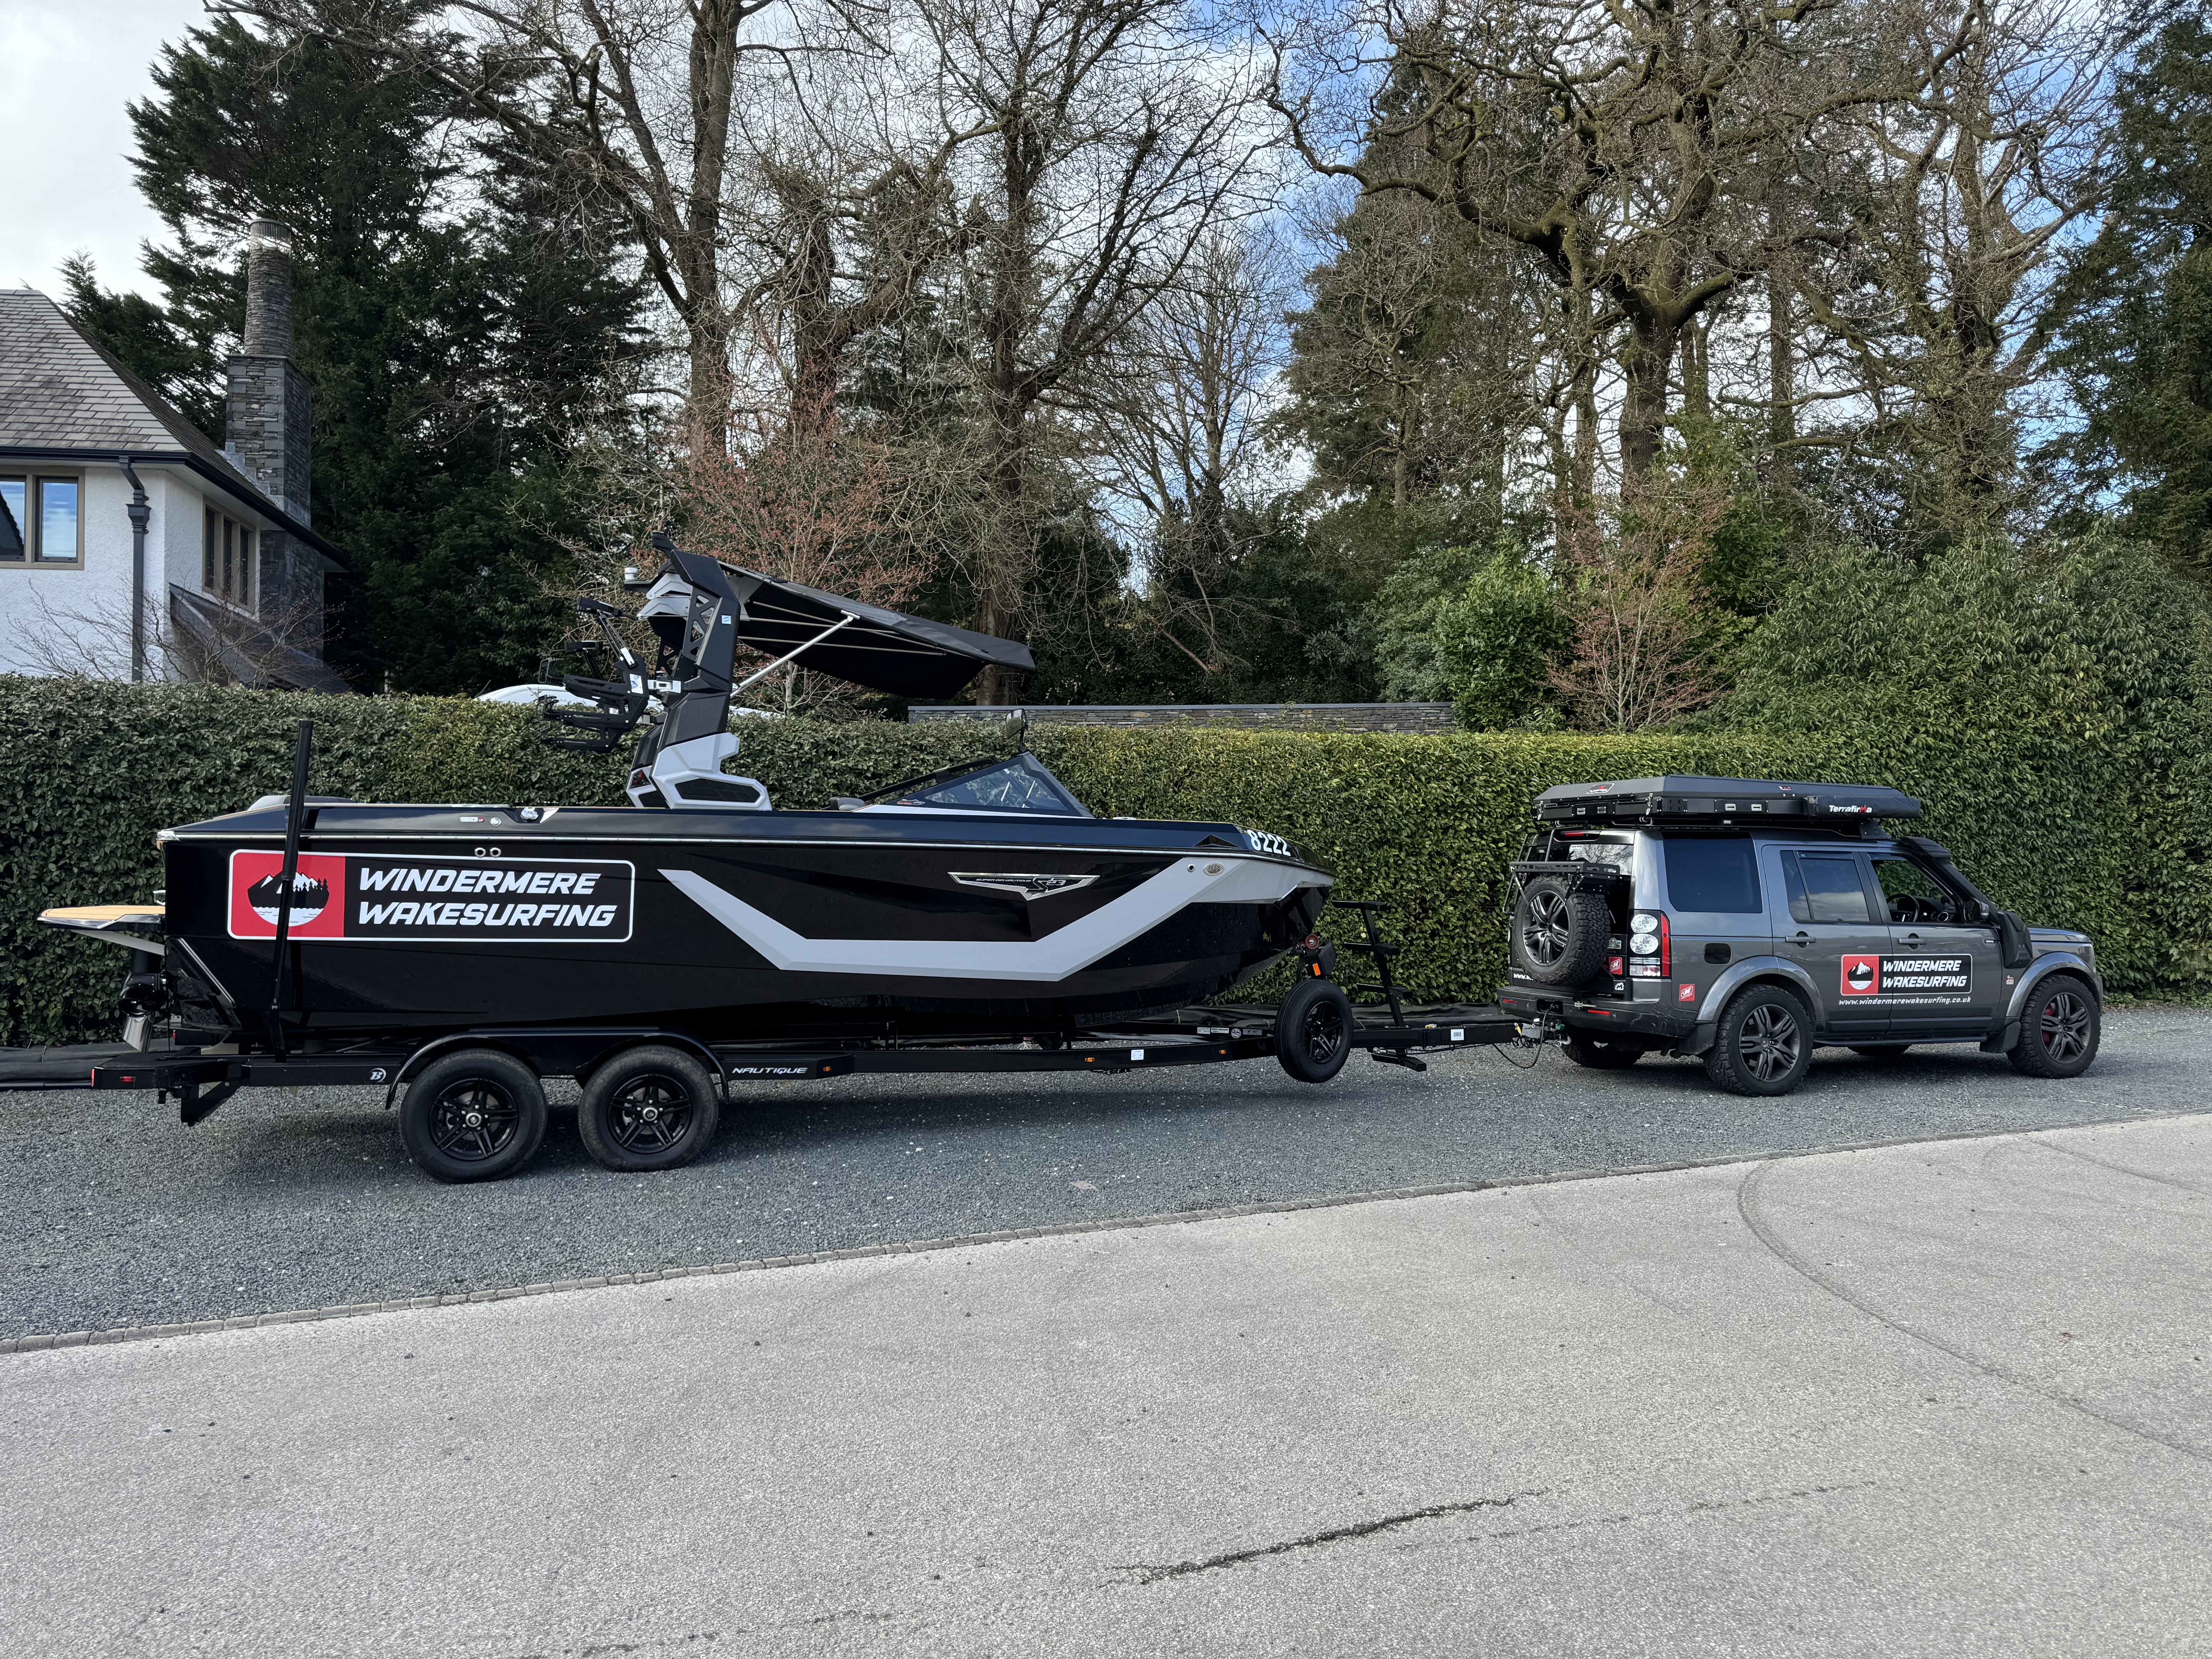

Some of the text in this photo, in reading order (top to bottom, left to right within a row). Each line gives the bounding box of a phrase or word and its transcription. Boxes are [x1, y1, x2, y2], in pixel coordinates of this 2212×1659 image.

[1247, 830, 1291, 857] 8222
[359, 867, 601, 895] WINDERMERE
[359, 901, 618, 927] WAKESURFING
[1883, 960, 1962, 972] WINDERMERE
[1882, 975, 1968, 988] WAKESURFING
[1838, 996, 1972, 1006] www.windermerewakesurfing.co.uk
